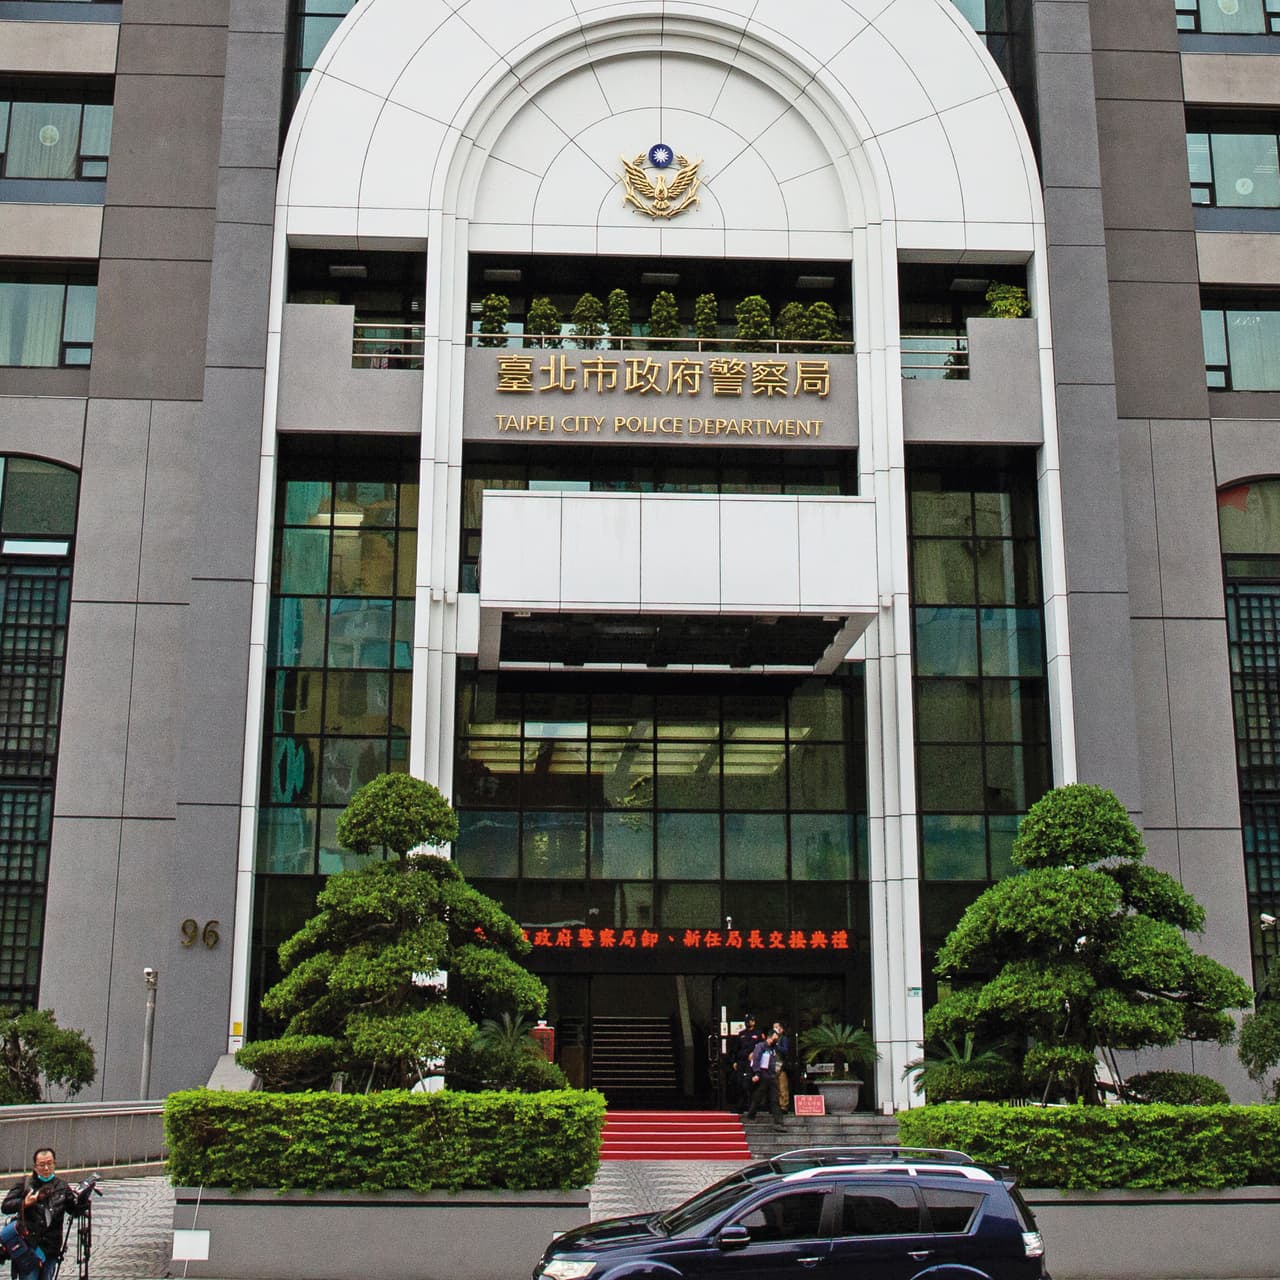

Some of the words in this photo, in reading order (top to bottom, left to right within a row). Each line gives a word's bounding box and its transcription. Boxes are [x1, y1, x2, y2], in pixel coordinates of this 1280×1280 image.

[495, 354, 831, 399] 臺北市政府警察局
[495, 414, 555, 432] TAIPEI
[561, 415, 604, 433] CITY
[614, 416, 683, 434] POLICE
[689, 417, 824, 438] DEPARTMENT
[181, 918, 220, 950] 96
